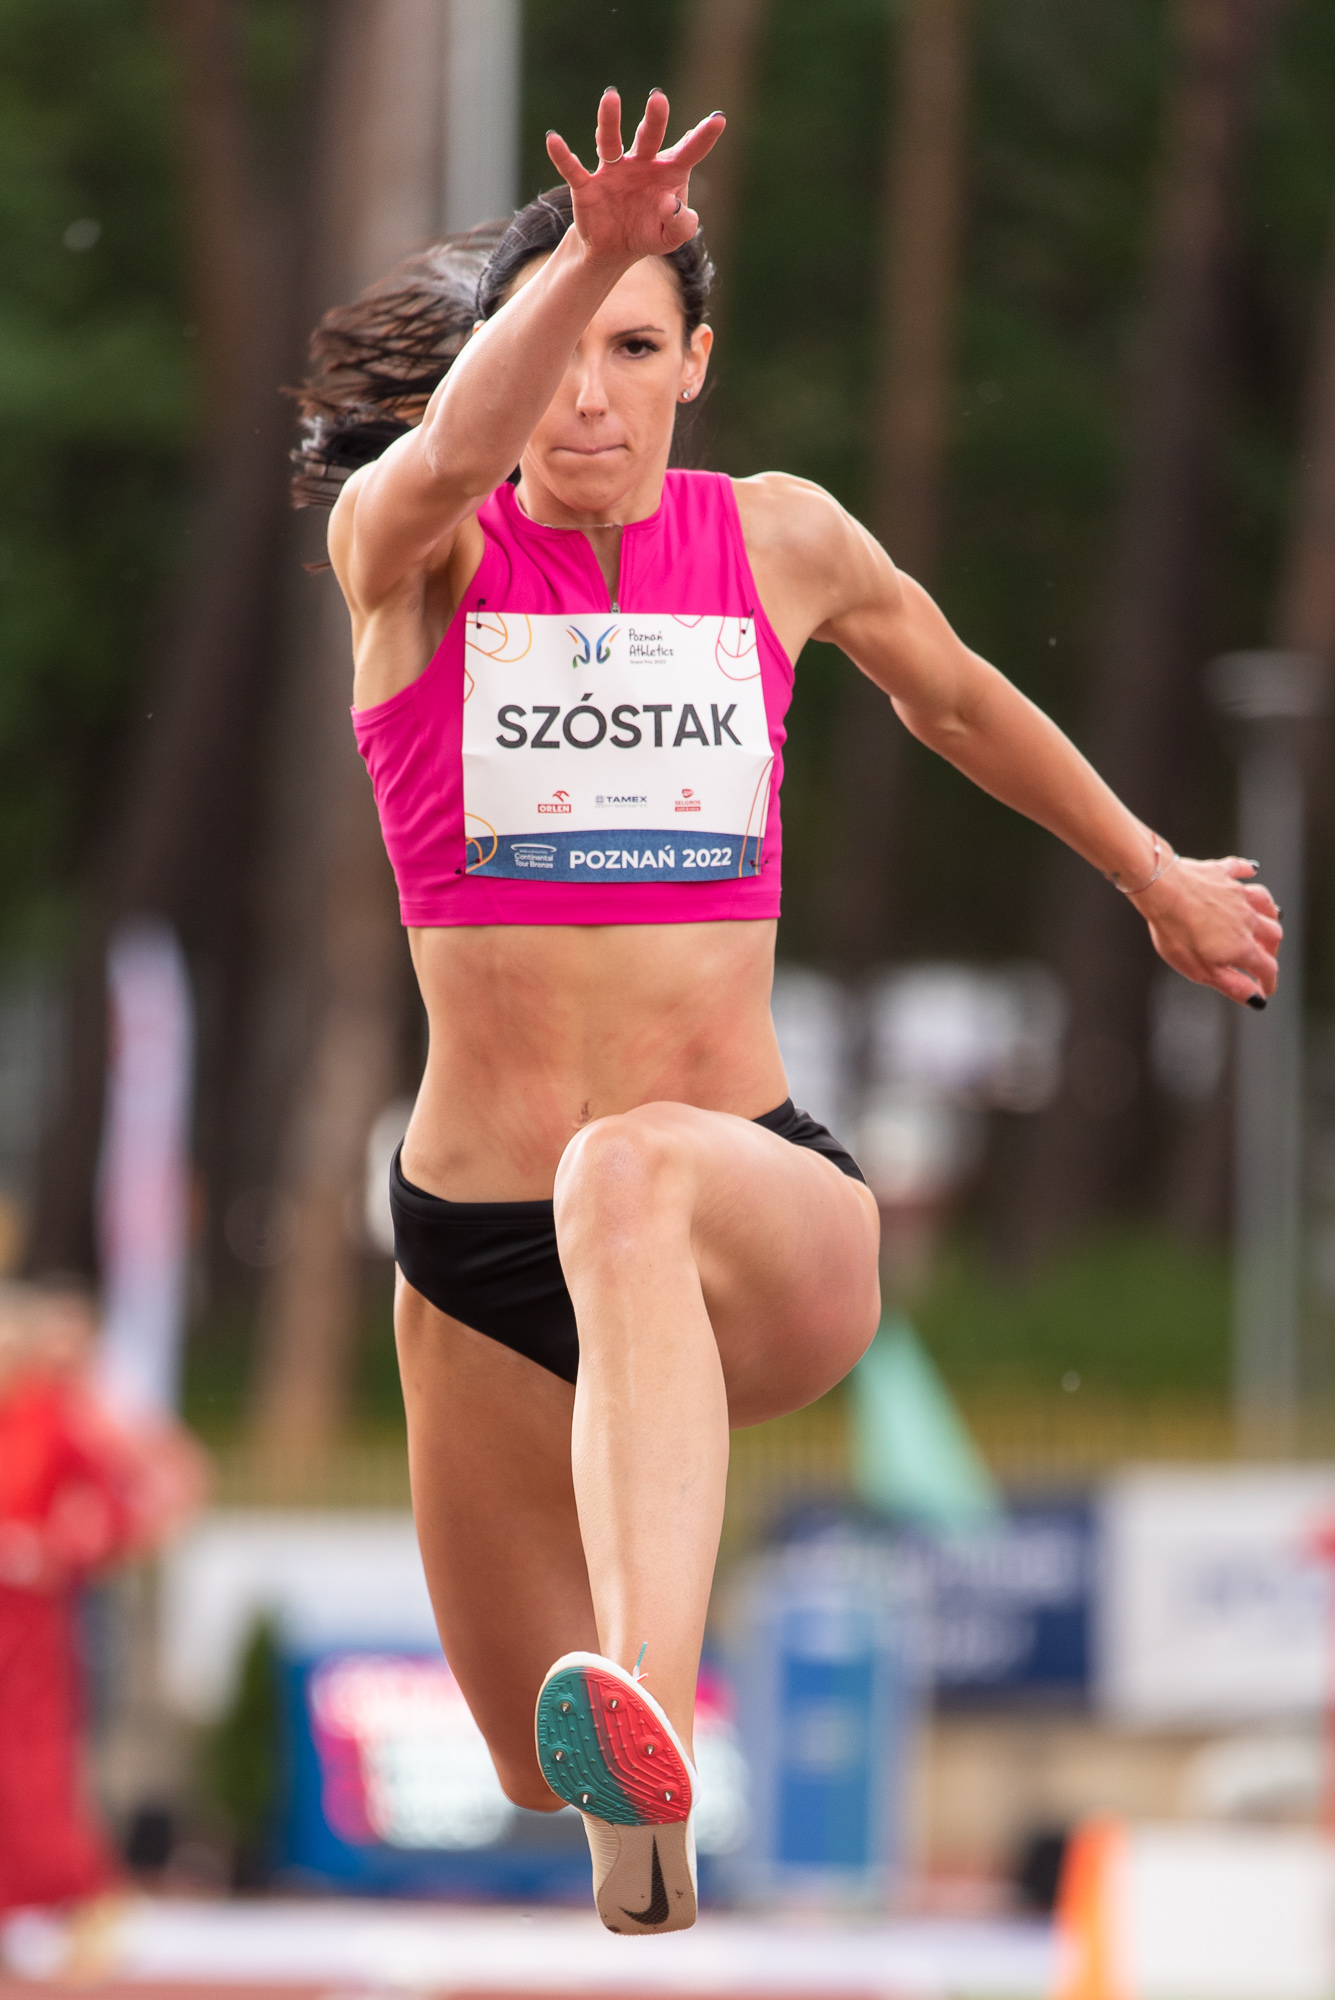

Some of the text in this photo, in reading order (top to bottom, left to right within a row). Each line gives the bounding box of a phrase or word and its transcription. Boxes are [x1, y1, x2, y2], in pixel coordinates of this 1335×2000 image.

[629, 628, 663, 641] Poznań
[630, 644, 674, 657] Athletics
[495, 692, 743, 750] SZÓSTAK
[539, 805, 570, 813] ORLEN
[514, 852, 554, 861] Continental
[569, 845, 732, 869] POZNAŃ 2022
[530, 861, 554, 869] Bronze
